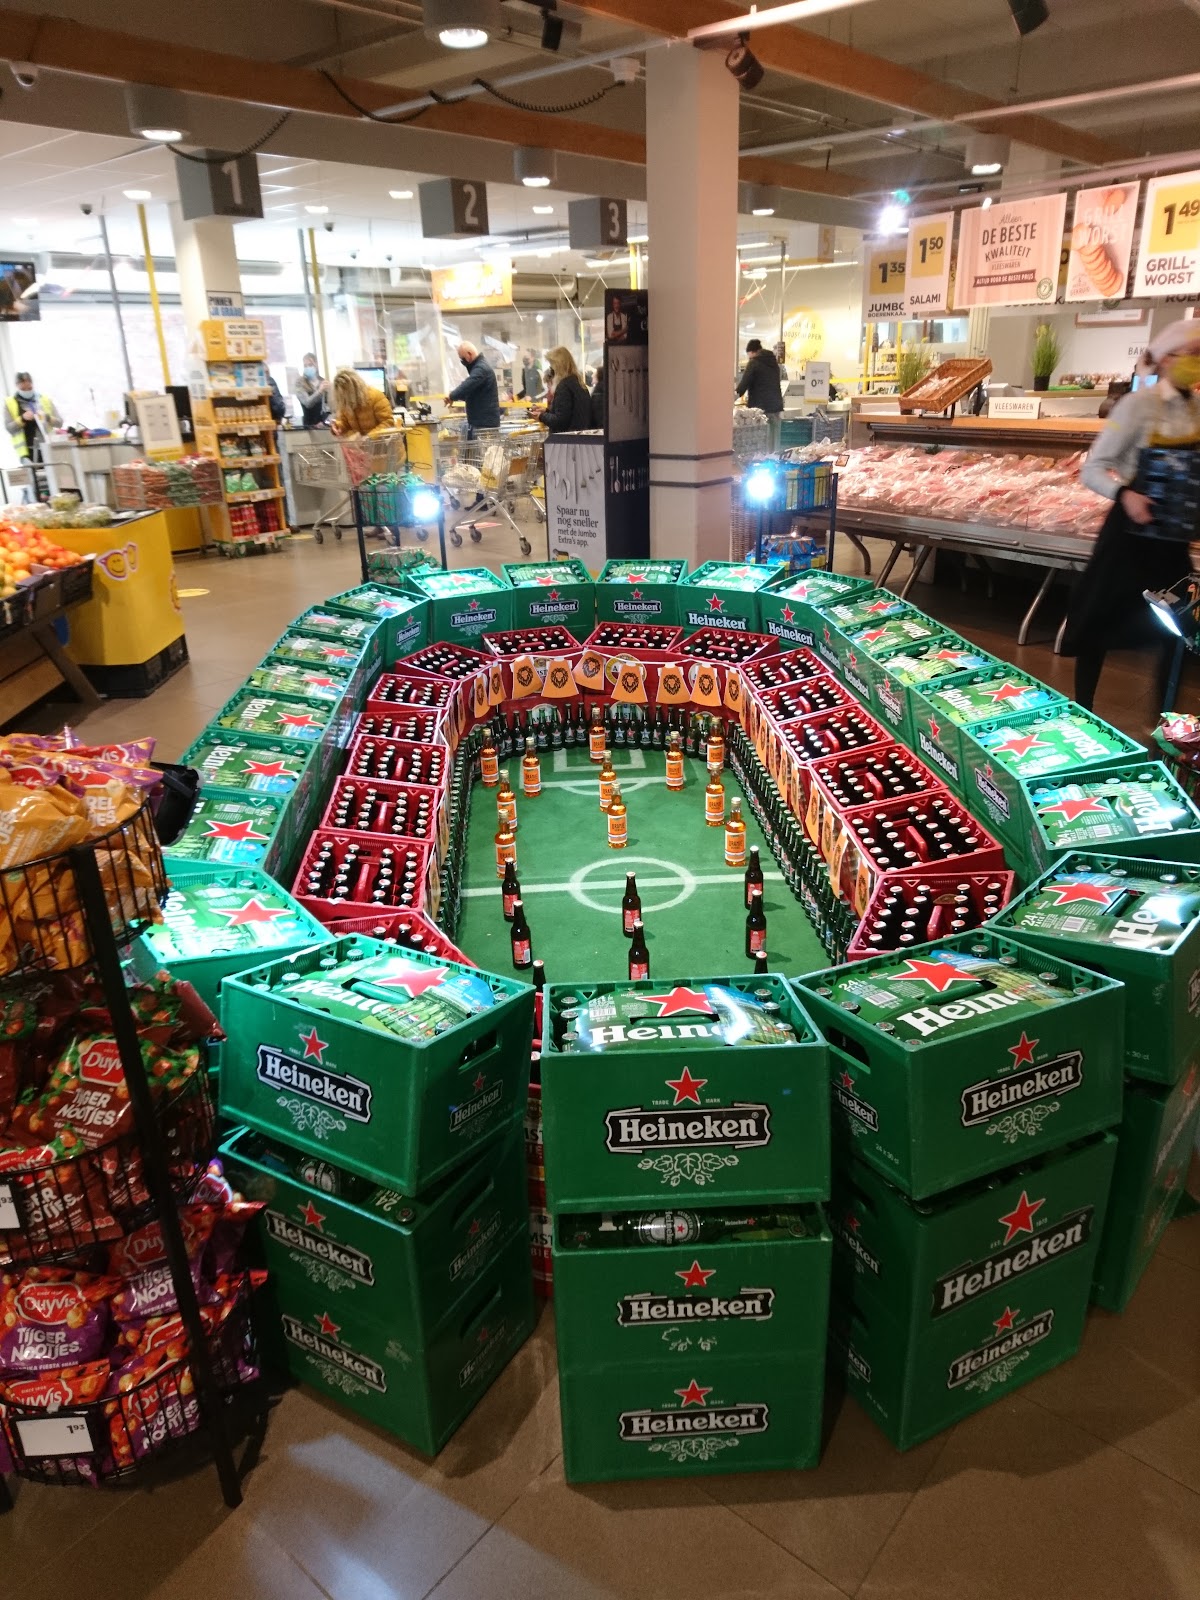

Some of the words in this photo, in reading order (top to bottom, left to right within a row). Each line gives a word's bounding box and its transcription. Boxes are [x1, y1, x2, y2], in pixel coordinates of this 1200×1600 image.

[221, 160, 242, 205] 1
[463, 184, 479, 225] 2
[608, 202, 620, 239] 3
[982, 228, 997, 245] DE
[1000, 222, 1037, 243] BESTE
[985, 244, 1031, 262] KWALITEIT
[1146, 256, 1196, 272] GRILL-
[1145, 271, 1194, 286] WORST
[909, 293, 941, 305] SALAMI
[994, 402, 1034, 410] VLEESWAREN
[556, 505, 578, 517] Spaar
[579, 508, 590, 517] nu
[557, 517, 572, 528] nog
[573, 517, 599, 528] sneller
[557, 528, 569, 536] met
[570, 528, 577, 536] de
[578, 529, 597, 538] Jumbo
[558, 536, 576, 545] Extra's
[577, 538, 589, 547] app.
[532, 603, 577, 614] Heineken
[617, 602, 659, 611] Heineken
[454, 613, 494, 625] Heineken
[689, 613, 746, 630] Heineken
[769, 622, 813, 646] Heineken
[844, 668, 870, 699] Heineken
[920, 732, 959, 781] Heineken
[977, 772, 1009, 815] Heineken
[266, 1055, 363, 1112] Heineken
[971, 1064, 1074, 1116] Heineken
[454, 1091, 500, 1126] Heineken
[619, 1115, 758, 1143] Heineken
[273, 1215, 366, 1277] Heineken
[453, 1221, 499, 1275] Heineken
[940, 1222, 1084, 1310] Heineken
[133, 1267, 171, 1288] TIJGE
[136, 1283, 175, 1308] NOOT
[630, 1298, 763, 1320] Heineken
[17, 1328, 66, 1346] TIJGER
[11, 1341, 80, 1362] NOOTJES
[290, 1322, 379, 1385] Heineken
[957, 1322, 1045, 1378] Heineken
[631, 1413, 757, 1434] Heineken
